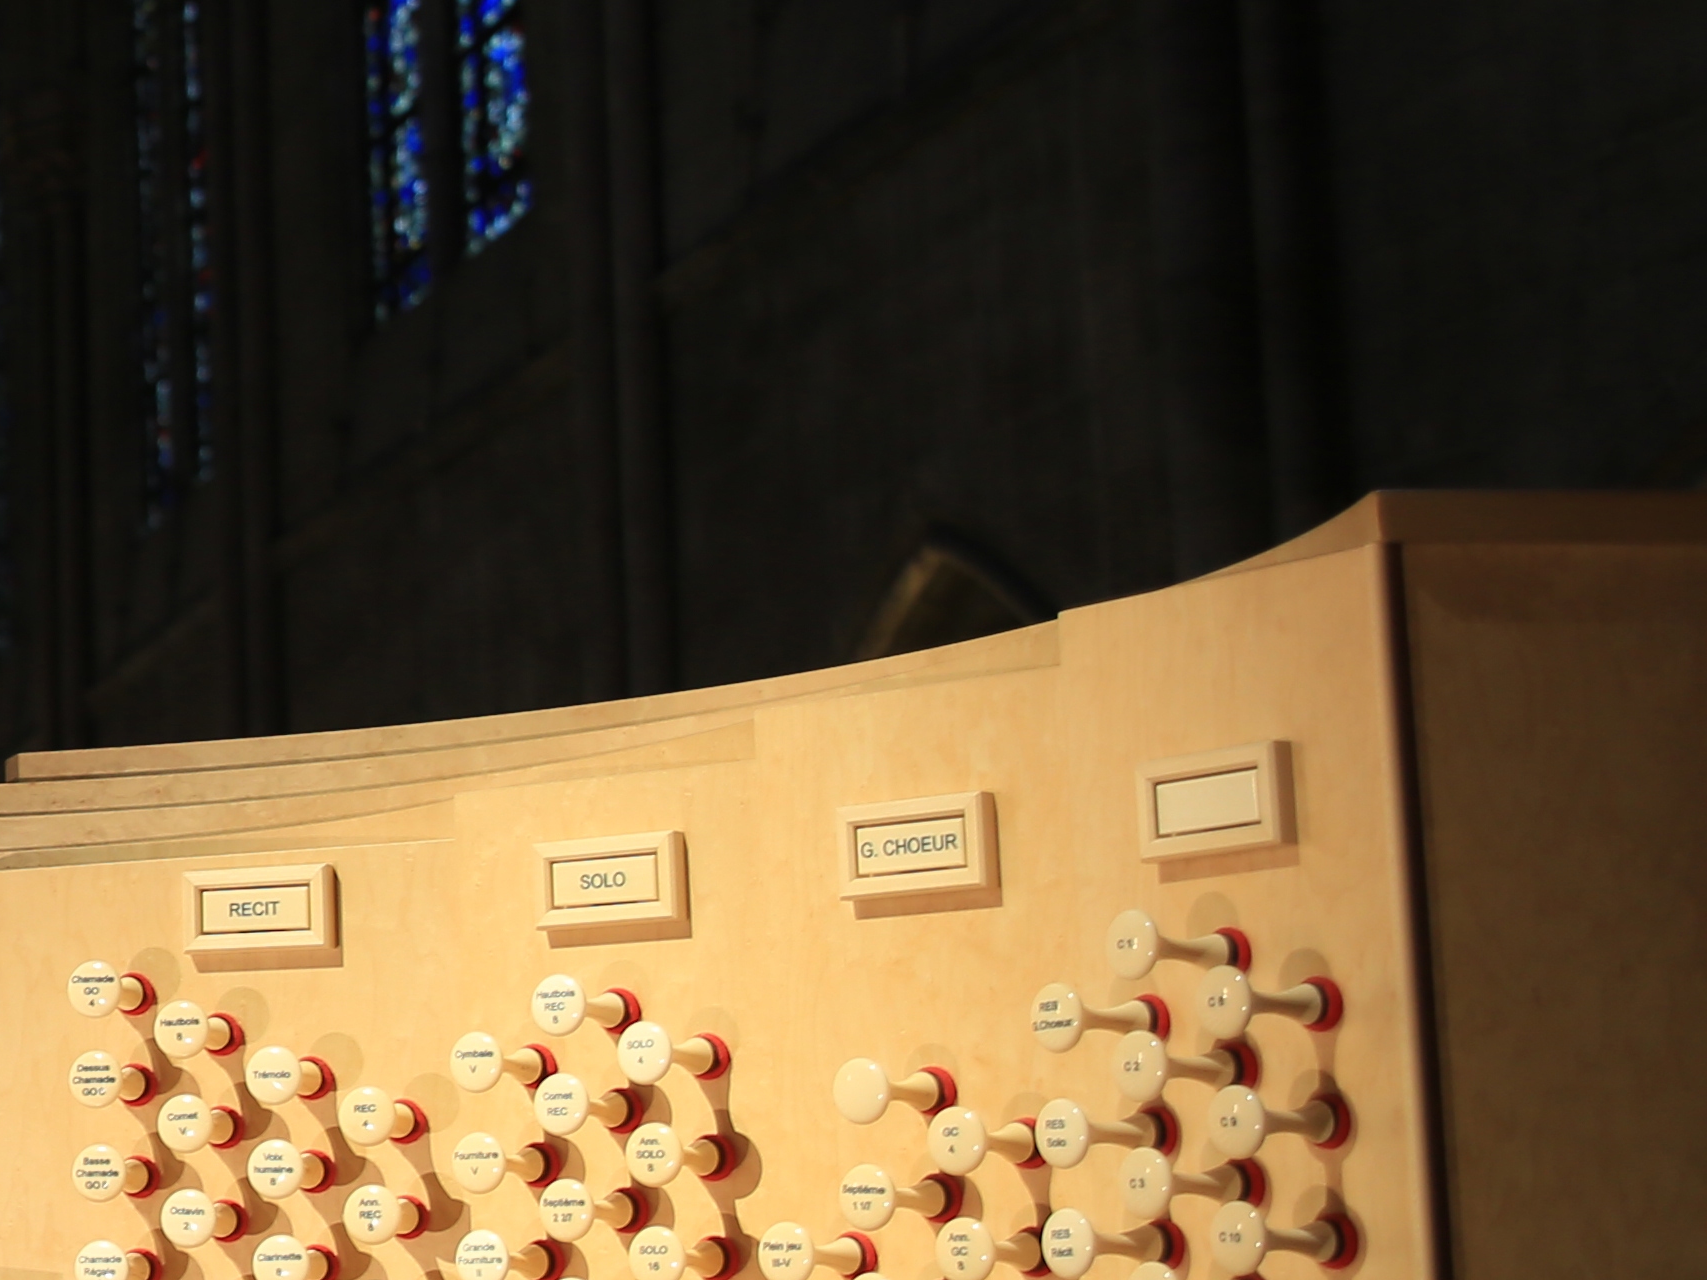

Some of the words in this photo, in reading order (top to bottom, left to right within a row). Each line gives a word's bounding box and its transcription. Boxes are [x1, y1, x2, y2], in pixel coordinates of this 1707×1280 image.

[860, 841, 879, 859] G.
[882, 832, 959, 857] CHOEUR
[579, 870, 627, 891] SOLO
[228, 900, 281, 918] RECIT
